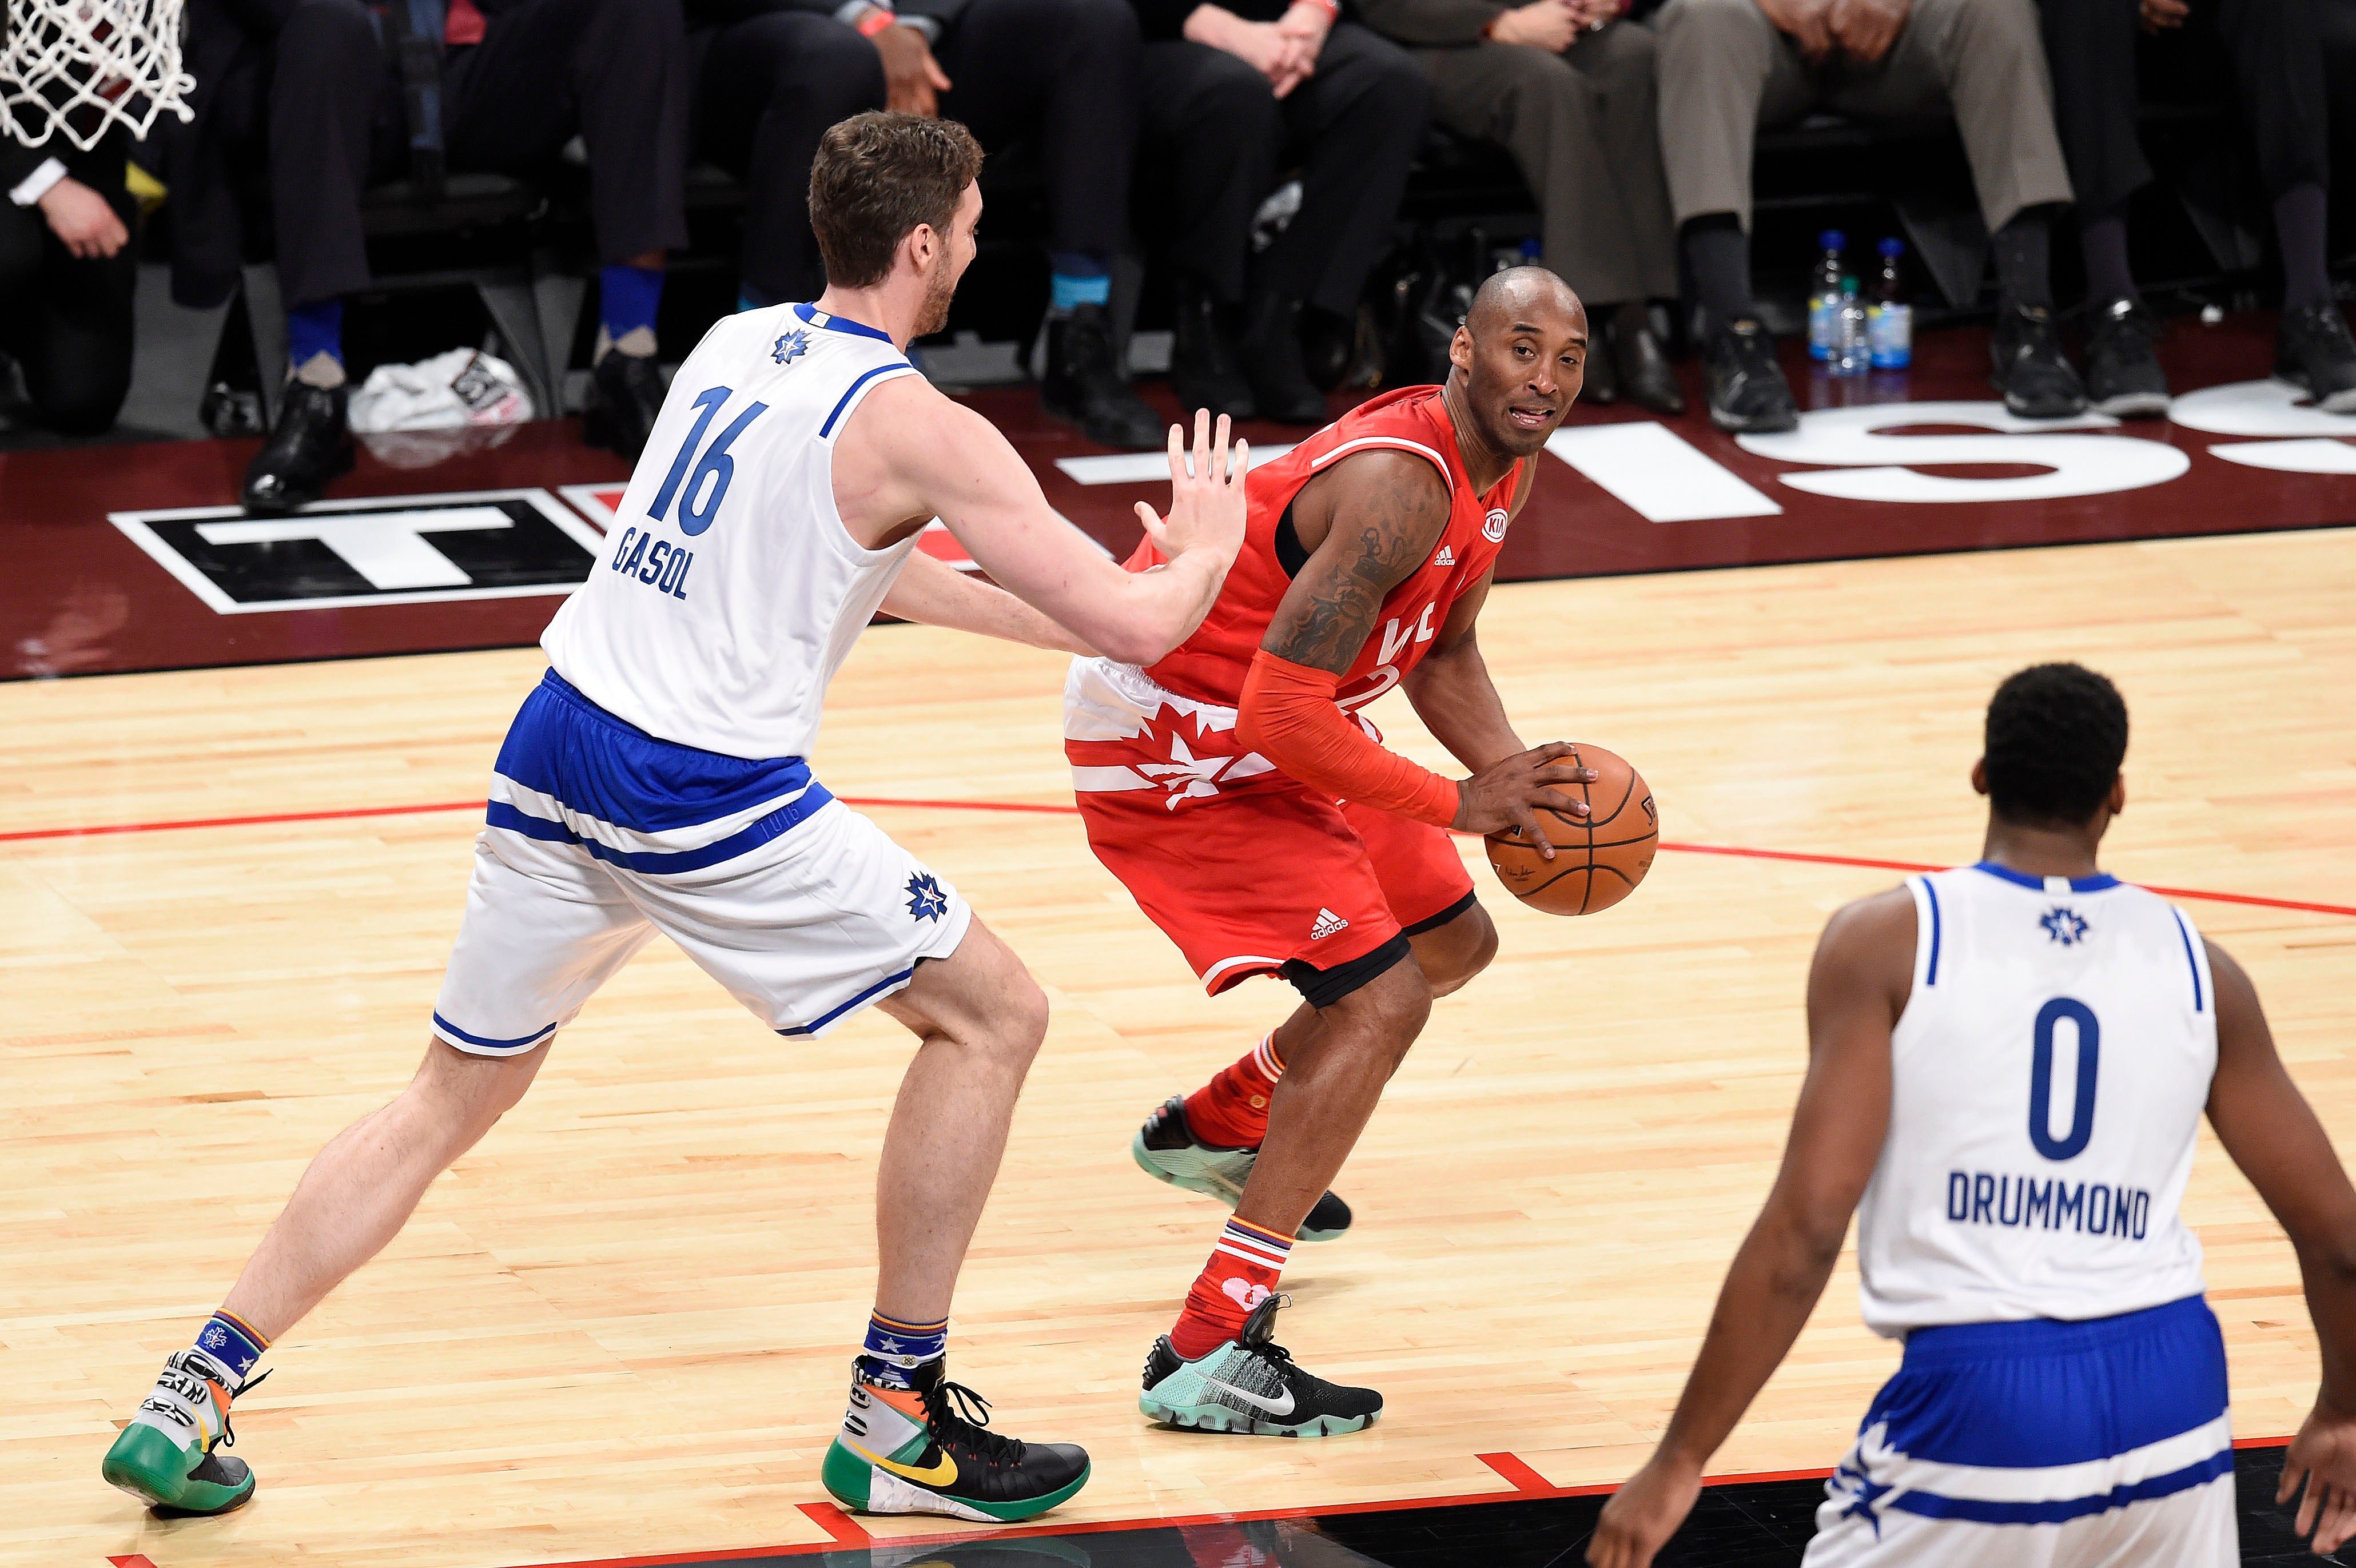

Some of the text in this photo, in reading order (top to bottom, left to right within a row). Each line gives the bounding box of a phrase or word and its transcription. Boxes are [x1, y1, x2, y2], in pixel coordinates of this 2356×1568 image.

[647, 385, 770, 537] 16
[1488, 517, 1505, 534] KIA
[612, 527, 694, 600] GASOL
[1311, 919, 1349, 940] adidas
[2028, 996, 2100, 1162] 0
[1948, 1171, 2150, 1240] DRUMMOND
